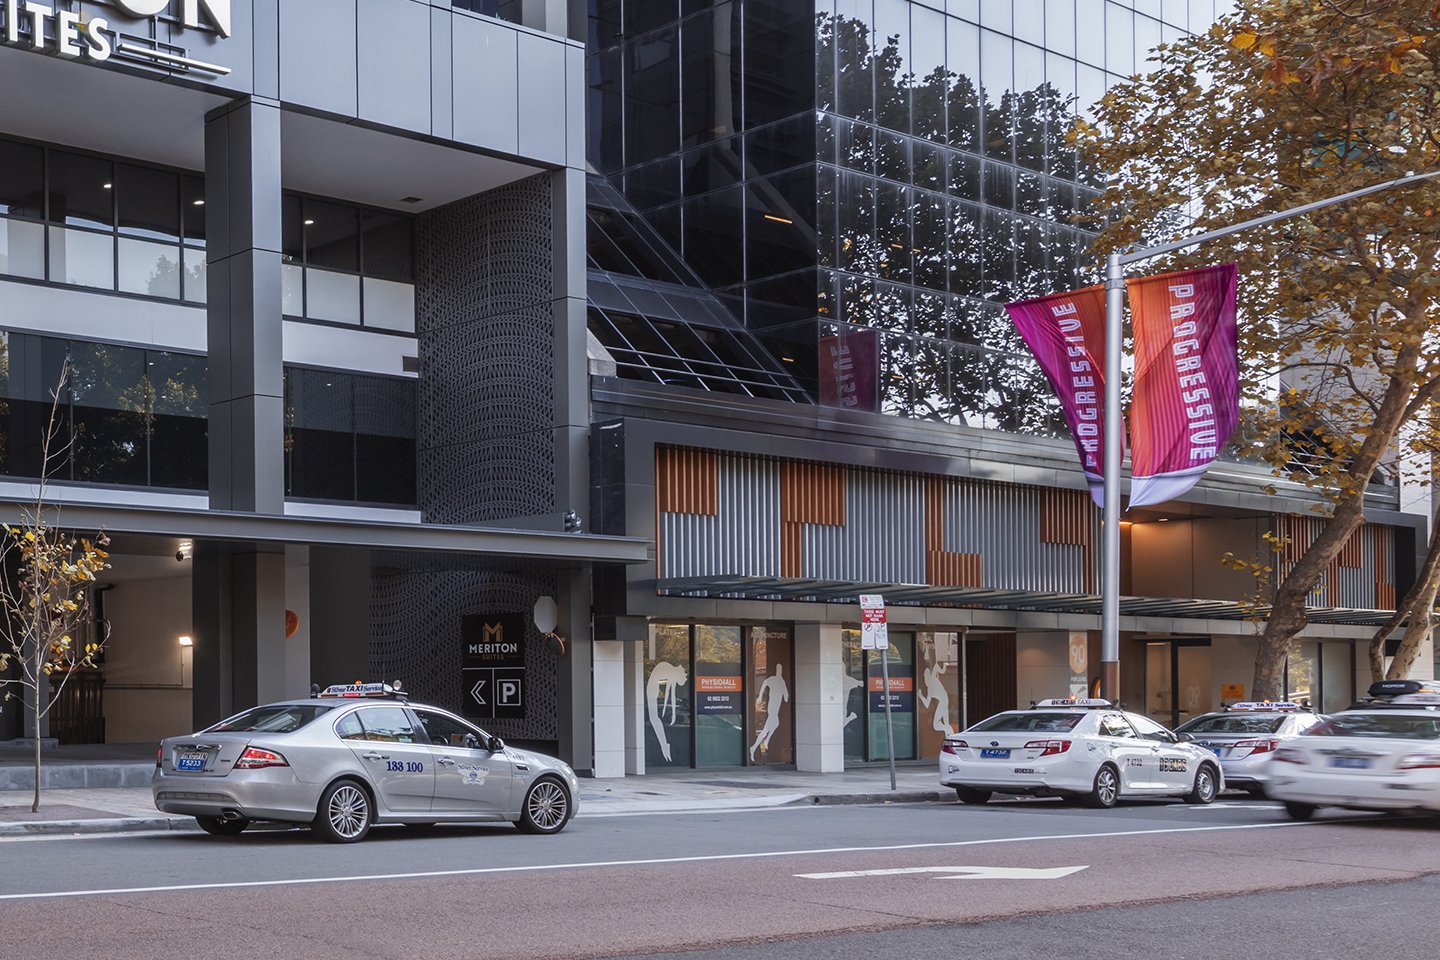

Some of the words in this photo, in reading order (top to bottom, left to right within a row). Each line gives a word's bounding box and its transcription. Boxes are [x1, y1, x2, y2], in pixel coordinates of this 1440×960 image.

[1168, 283, 1218, 461] PROGRESSIVE
[469, 643, 518, 654] MERITON
[502, 682, 516, 703] P
[386, 760, 404, 772] 133
[407, 761, 424, 773] 100
